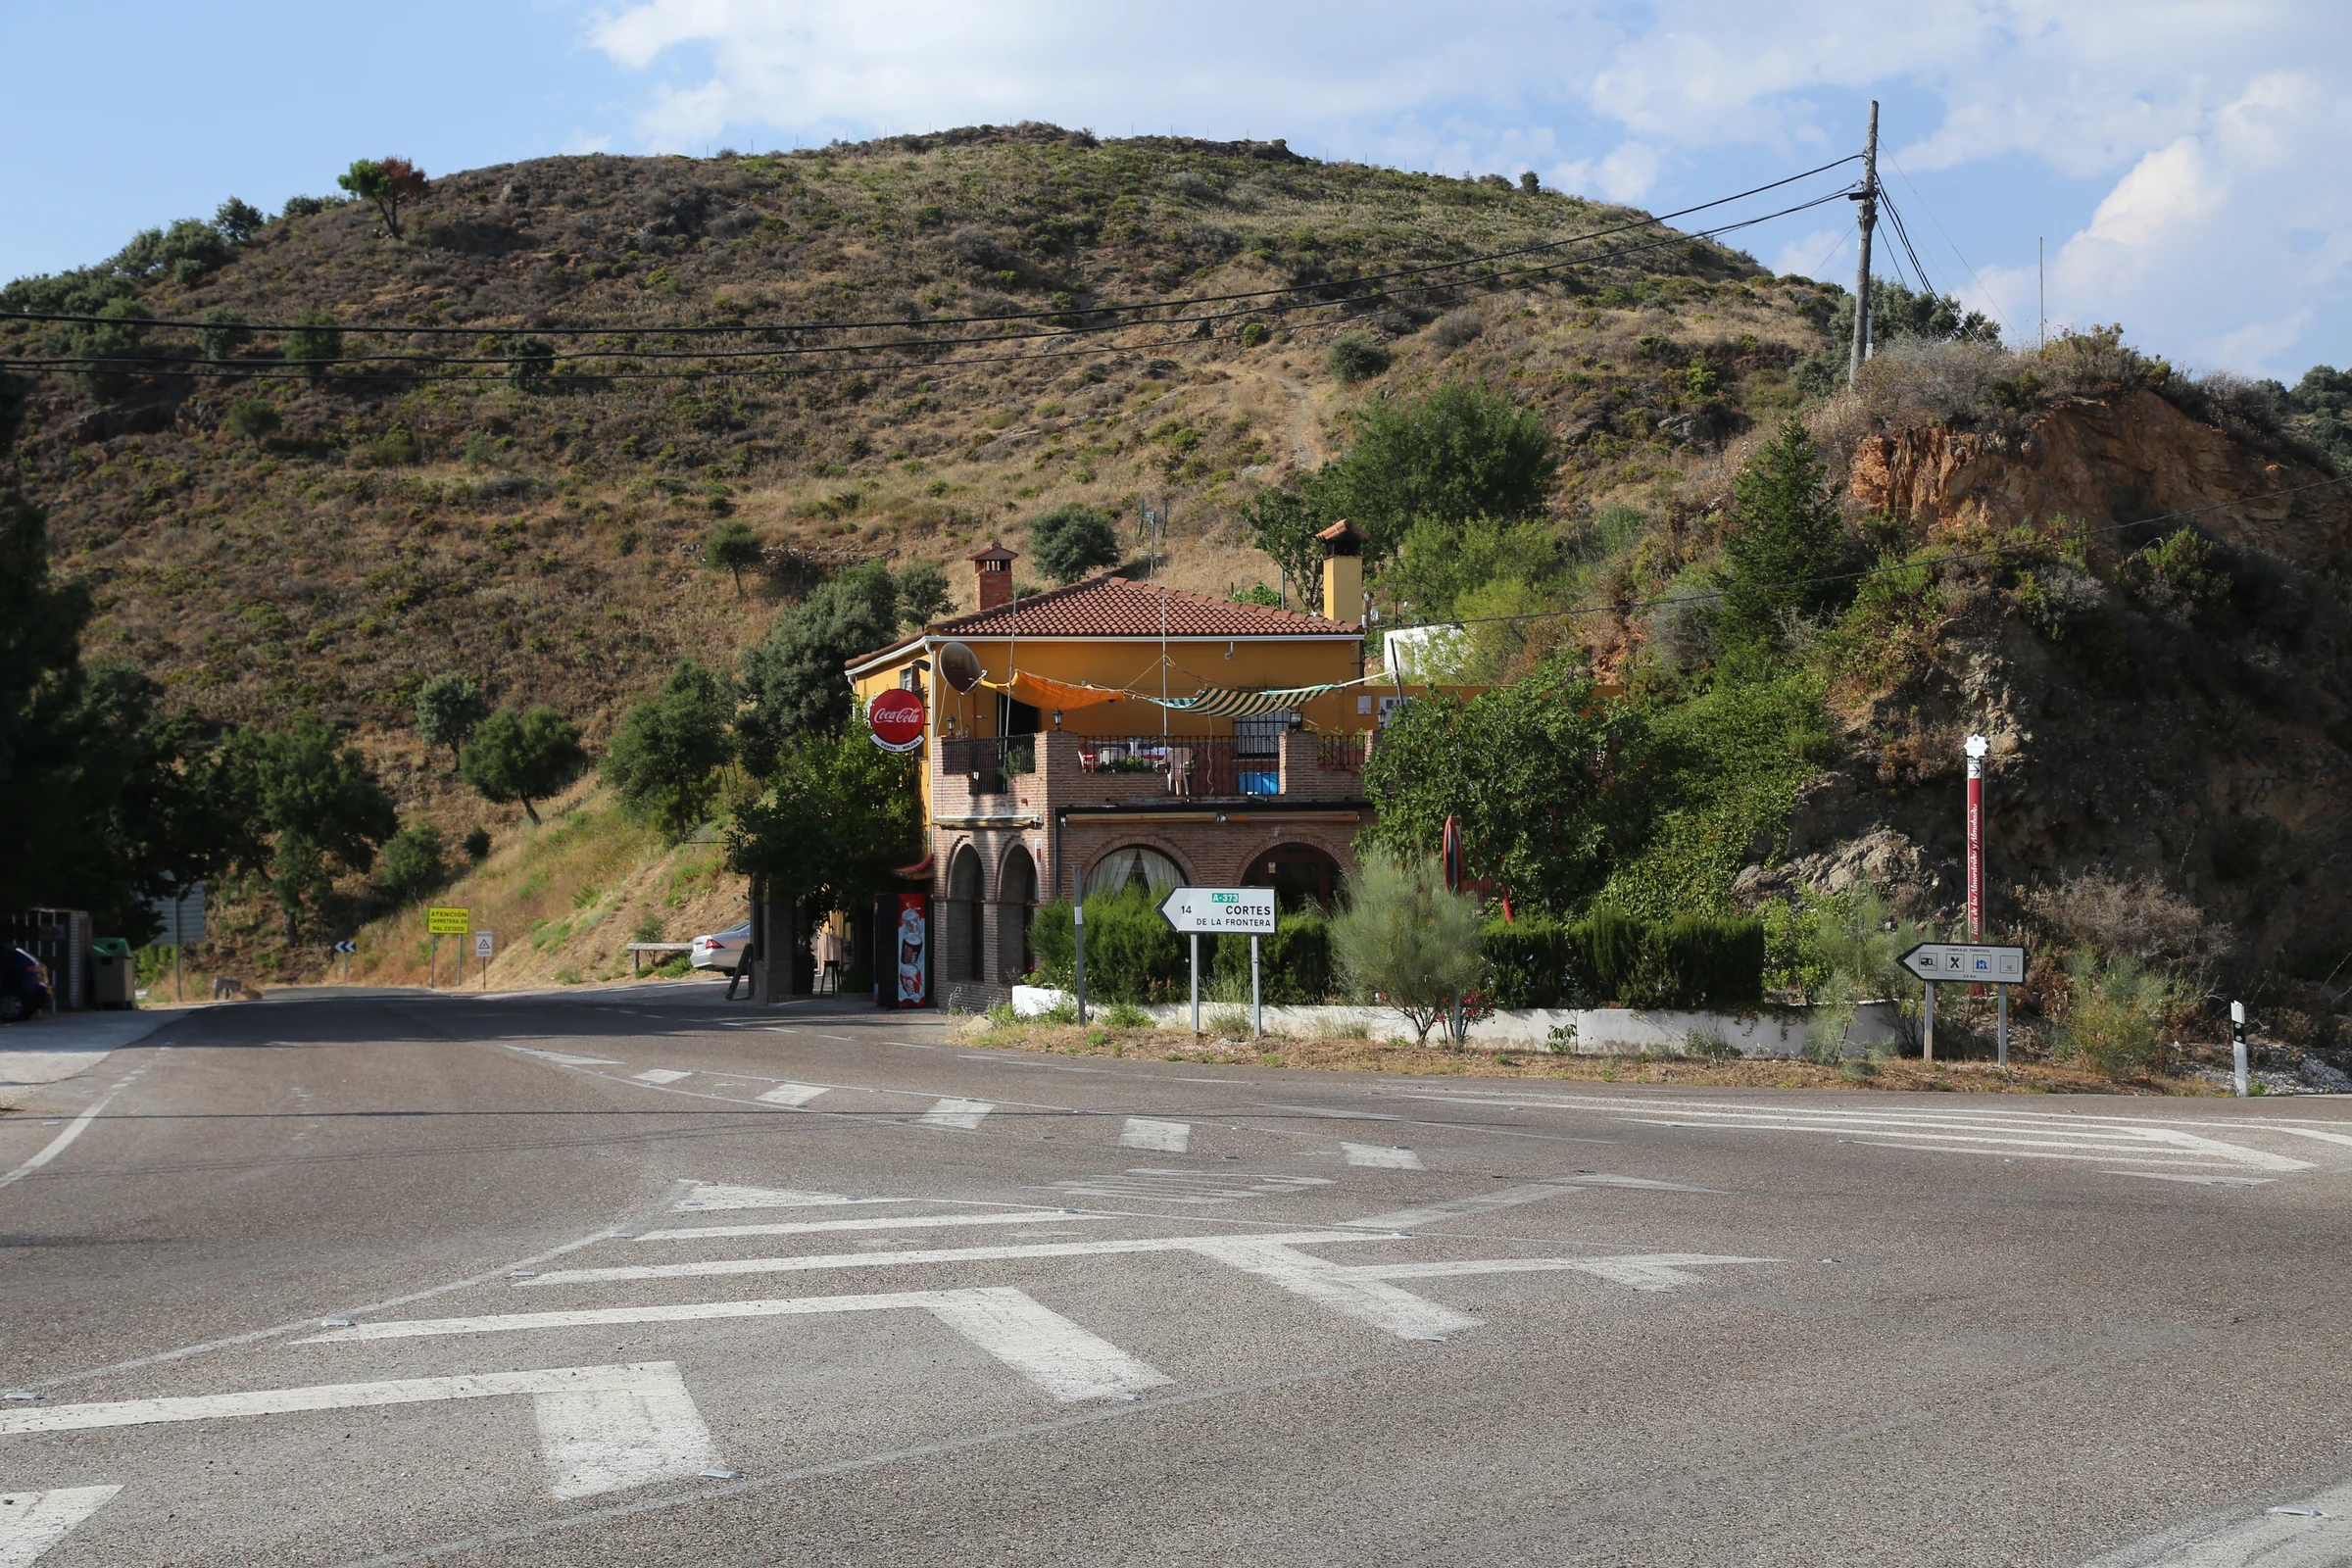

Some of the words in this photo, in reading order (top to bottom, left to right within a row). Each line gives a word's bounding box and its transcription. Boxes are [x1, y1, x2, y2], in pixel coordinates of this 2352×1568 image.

[873, 708, 920, 723] Coca-Cola
[903, 740, 919, 750] SOLERA
[1181, 906, 1192, 914] 14
[1225, 906, 1271, 915] CORTES
